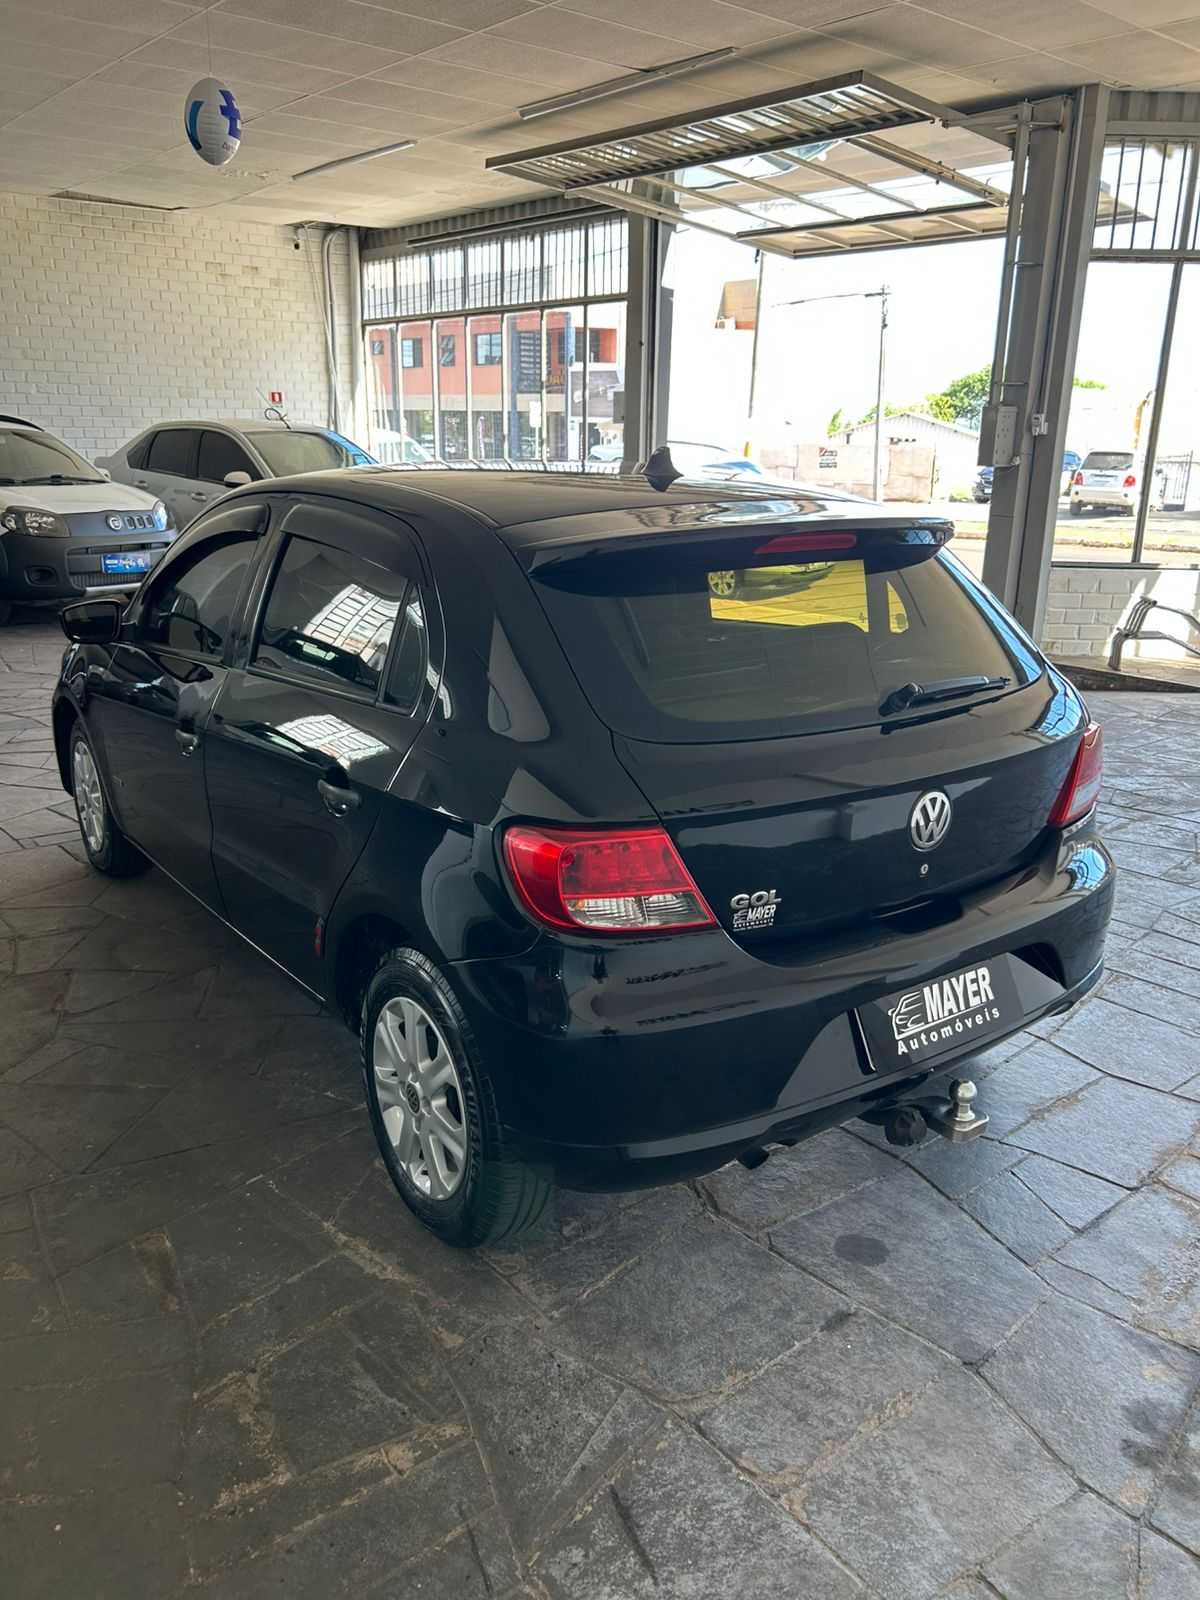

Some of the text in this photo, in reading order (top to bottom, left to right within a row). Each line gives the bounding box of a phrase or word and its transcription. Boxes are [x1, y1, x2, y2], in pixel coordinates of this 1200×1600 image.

[730, 889, 782, 910] GOL
[747, 903, 776, 921] MAYER
[923, 967, 995, 1023] MAYER
[898, 1008, 1000, 1056] Automóveis
